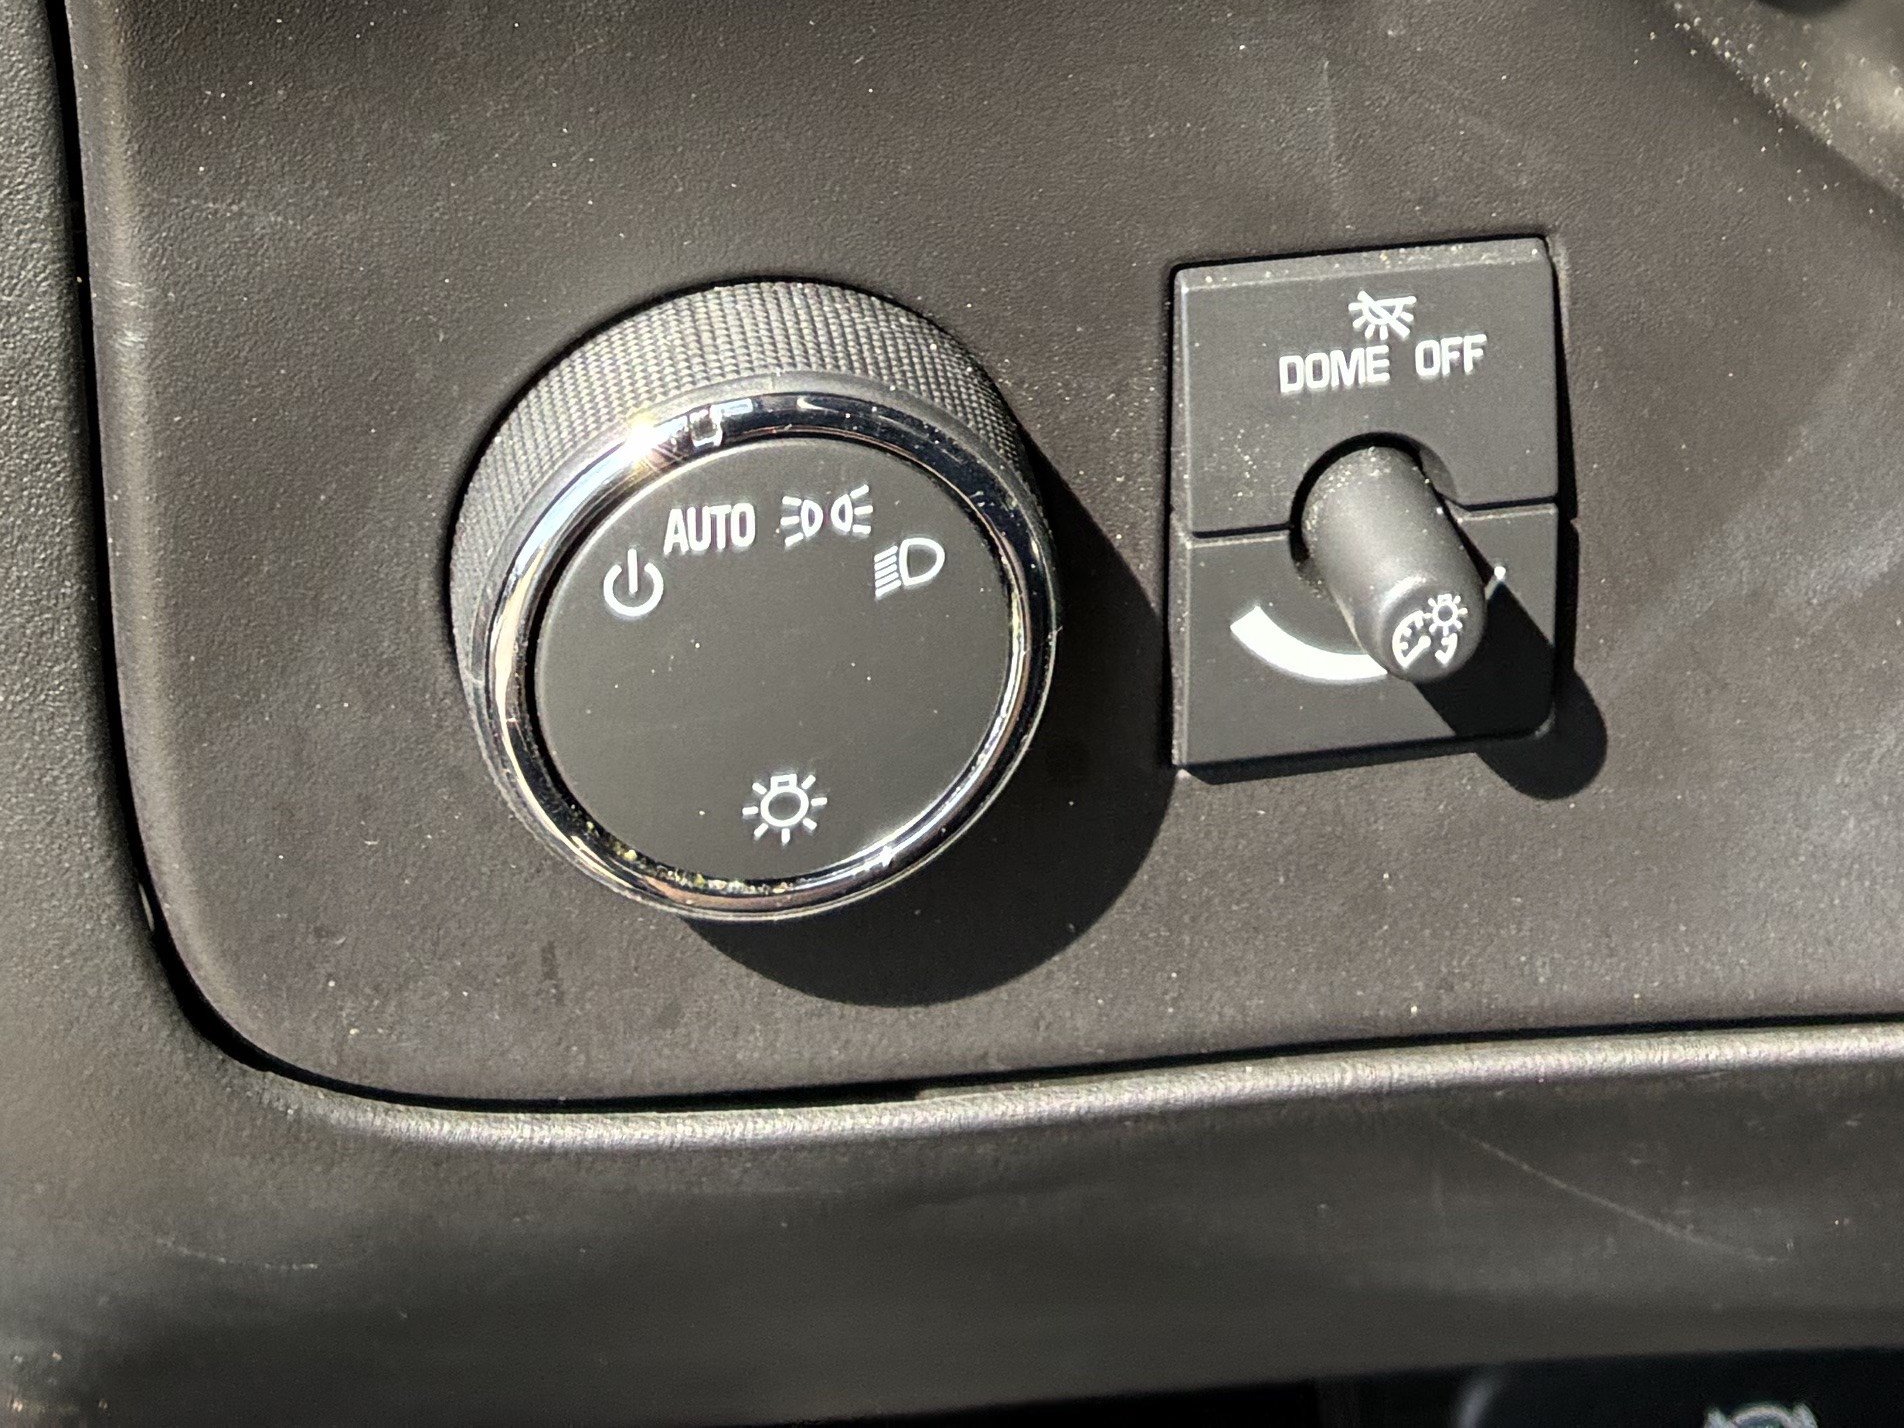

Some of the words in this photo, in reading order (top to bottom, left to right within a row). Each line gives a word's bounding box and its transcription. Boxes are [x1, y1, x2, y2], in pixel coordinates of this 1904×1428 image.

[1279, 344, 1390, 394] DOME
[1415, 334, 1487, 379] OFF
[663, 502, 756, 555] AUTO
